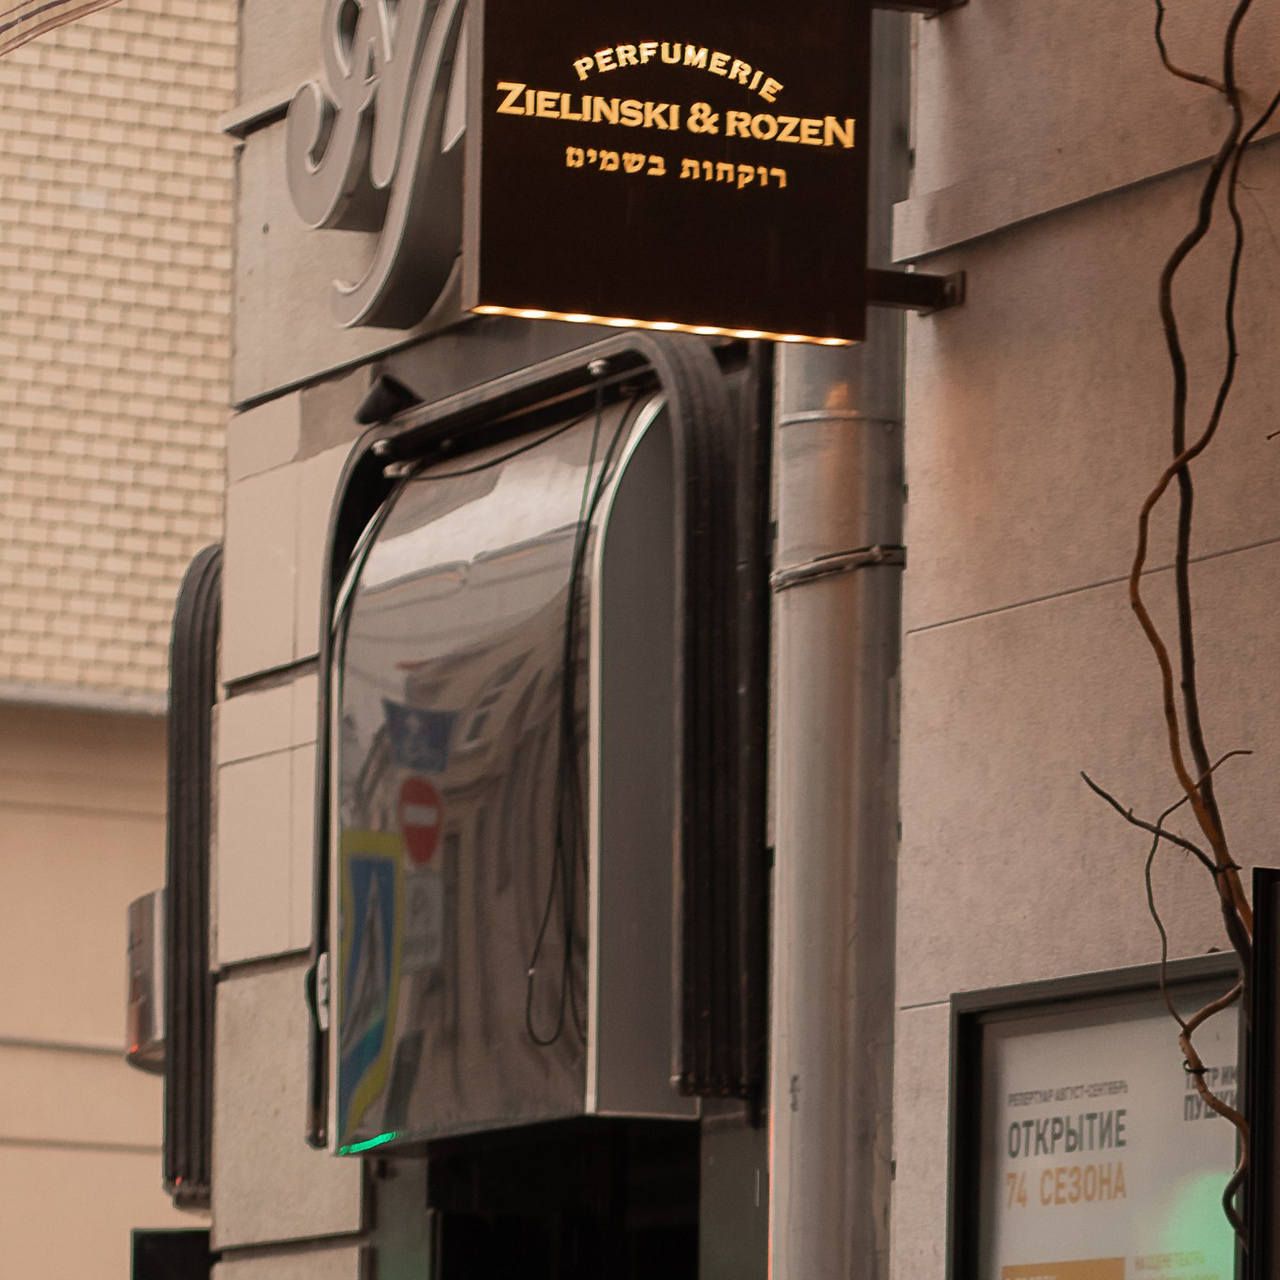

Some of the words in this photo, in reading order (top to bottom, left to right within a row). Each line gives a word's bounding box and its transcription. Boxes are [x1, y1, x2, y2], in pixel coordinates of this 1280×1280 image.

[573, 42, 784, 103] PERFUMERIE
[686, 102, 719, 136] &
[680, 158, 787, 190] רוקחות
[1008, 1109, 1127, 1159] ОТКРЫТИЕ
[1005, 1172, 1027, 1209] 74
[1039, 1162, 1127, 1206] СЕЗОНА
